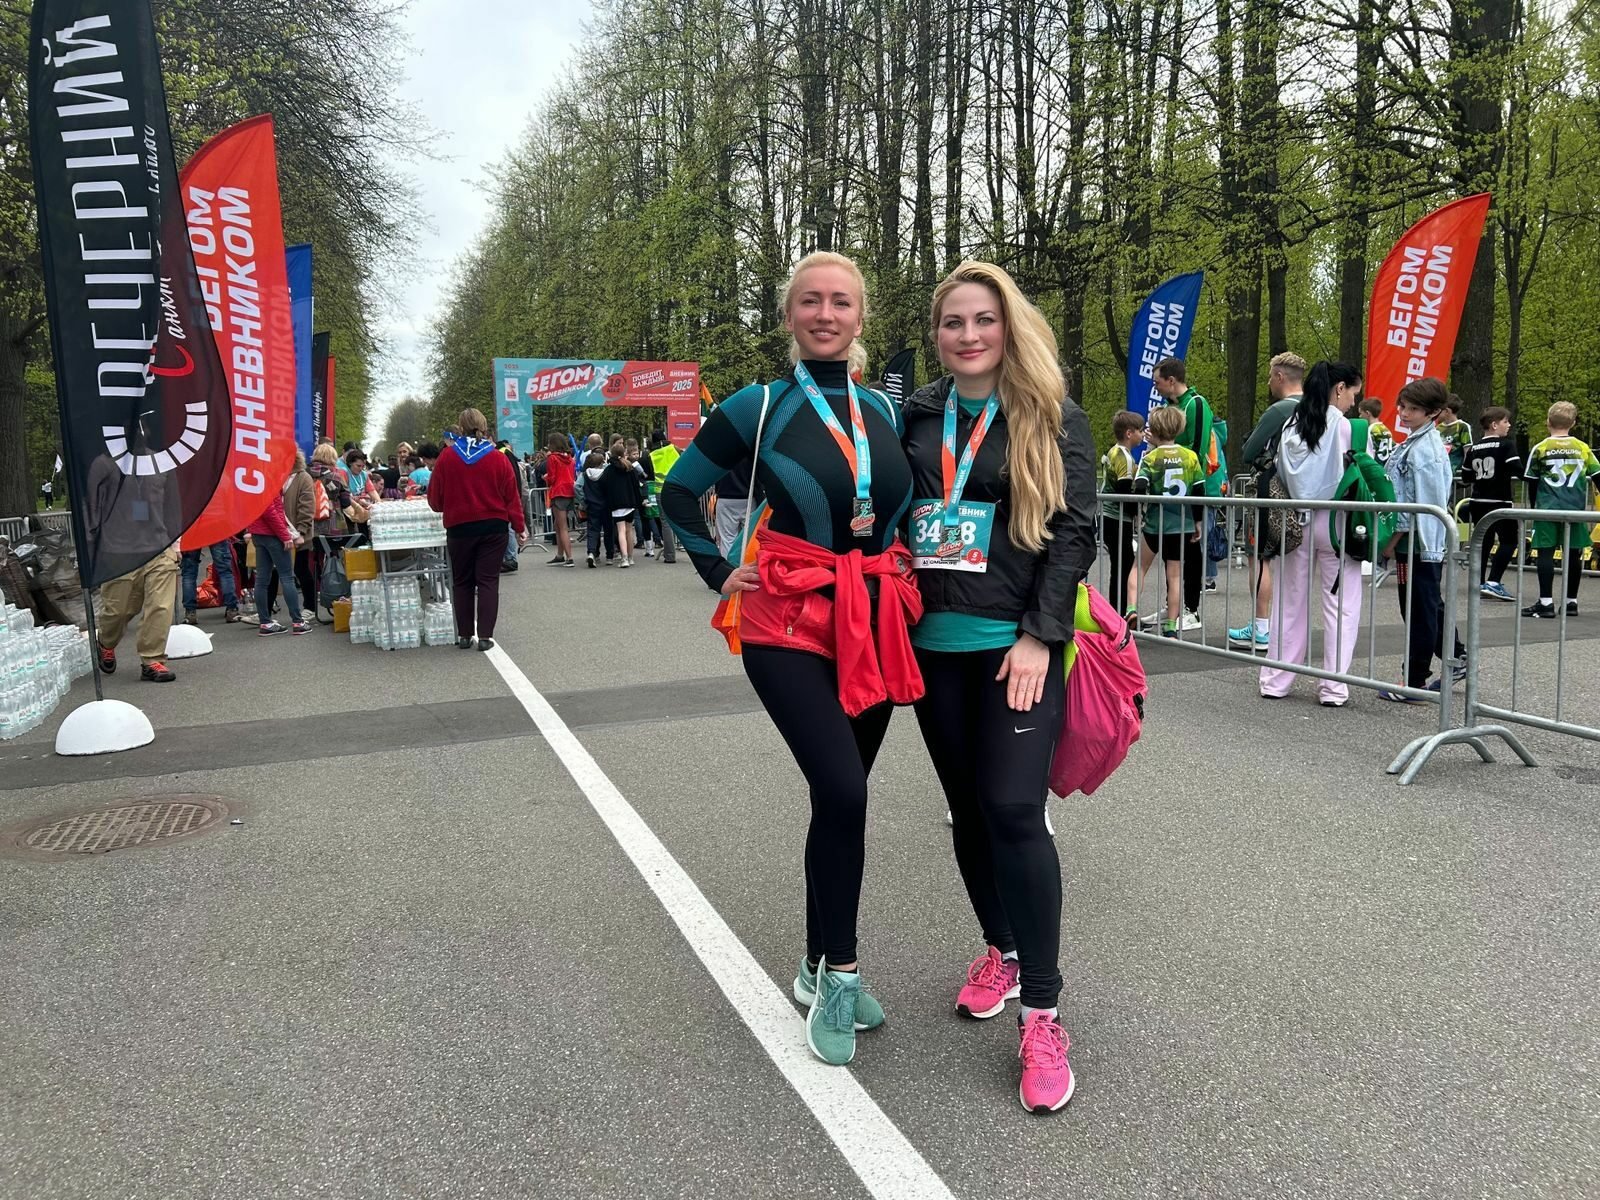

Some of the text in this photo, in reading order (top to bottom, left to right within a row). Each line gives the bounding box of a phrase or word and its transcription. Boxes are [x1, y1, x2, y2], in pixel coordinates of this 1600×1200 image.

[42, 14, 157, 397] ВЕЧЕРНИЙ
[1386, 245, 1428, 348] БЕГОМ
[216, 186, 272, 495] С ДНЕВНИКОМ
[1139, 301, 1166, 380] БЕГОМ
[525, 365, 592, 394] БЕГОМ
[608, 378, 621, 388] 18
[632, 369, 664, 383] ПОБЕДИТ
[671, 378, 692, 393] 2025
[541, 384, 589, 400] ДНЕВНИКОМ
[1162, 468, 1187, 497] 5
[1472, 456, 1496, 480] 99
[1543, 458, 1584, 487] 37
